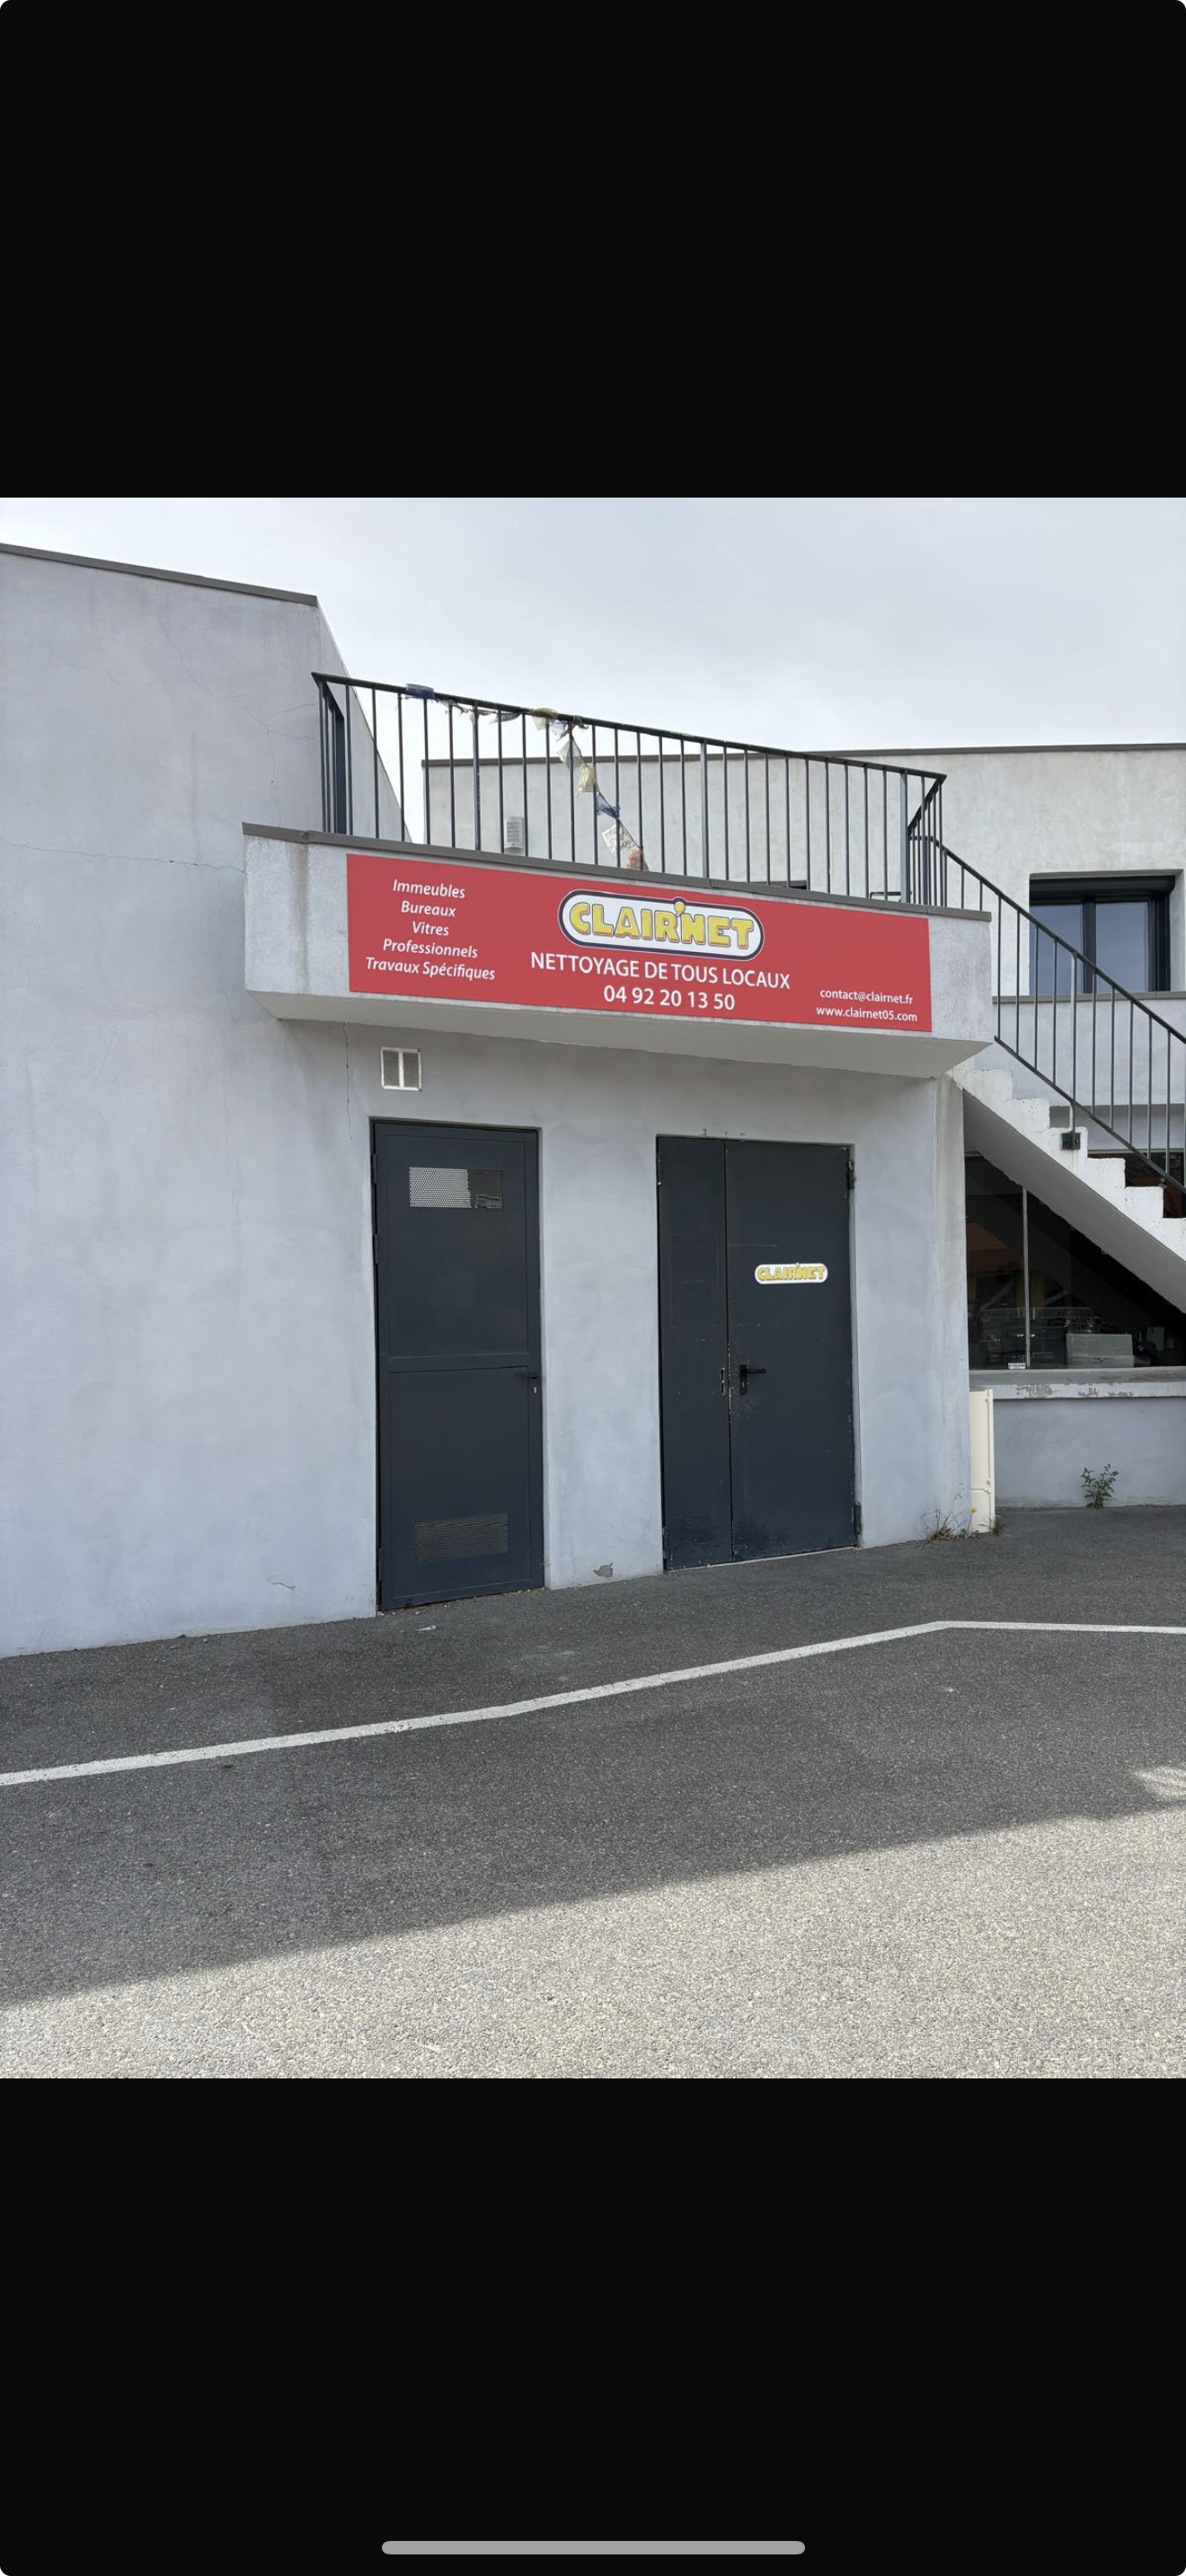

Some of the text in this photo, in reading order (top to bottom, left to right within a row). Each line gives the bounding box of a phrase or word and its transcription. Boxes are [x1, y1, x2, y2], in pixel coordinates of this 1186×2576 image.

[393, 878, 465, 899] Immeubles
[401, 900, 456, 917] Bureaux
[412, 921, 449, 937] Vitres
[569, 901, 754, 950] CLAIR'NET
[383, 939, 478, 958] Professionnels
[366, 957, 495, 981] Travaux Spécifiques
[531, 951, 791, 990] NETTOYAGE DE TOUS LOCAUX
[604, 984, 735, 1010] 04 92 20 13 50
[819, 989, 913, 1004] contact@clairnet.fr
[816, 1007, 917, 1022] www.clairnet05.com
[757, 1262, 825, 1281] CLAIR'NET
